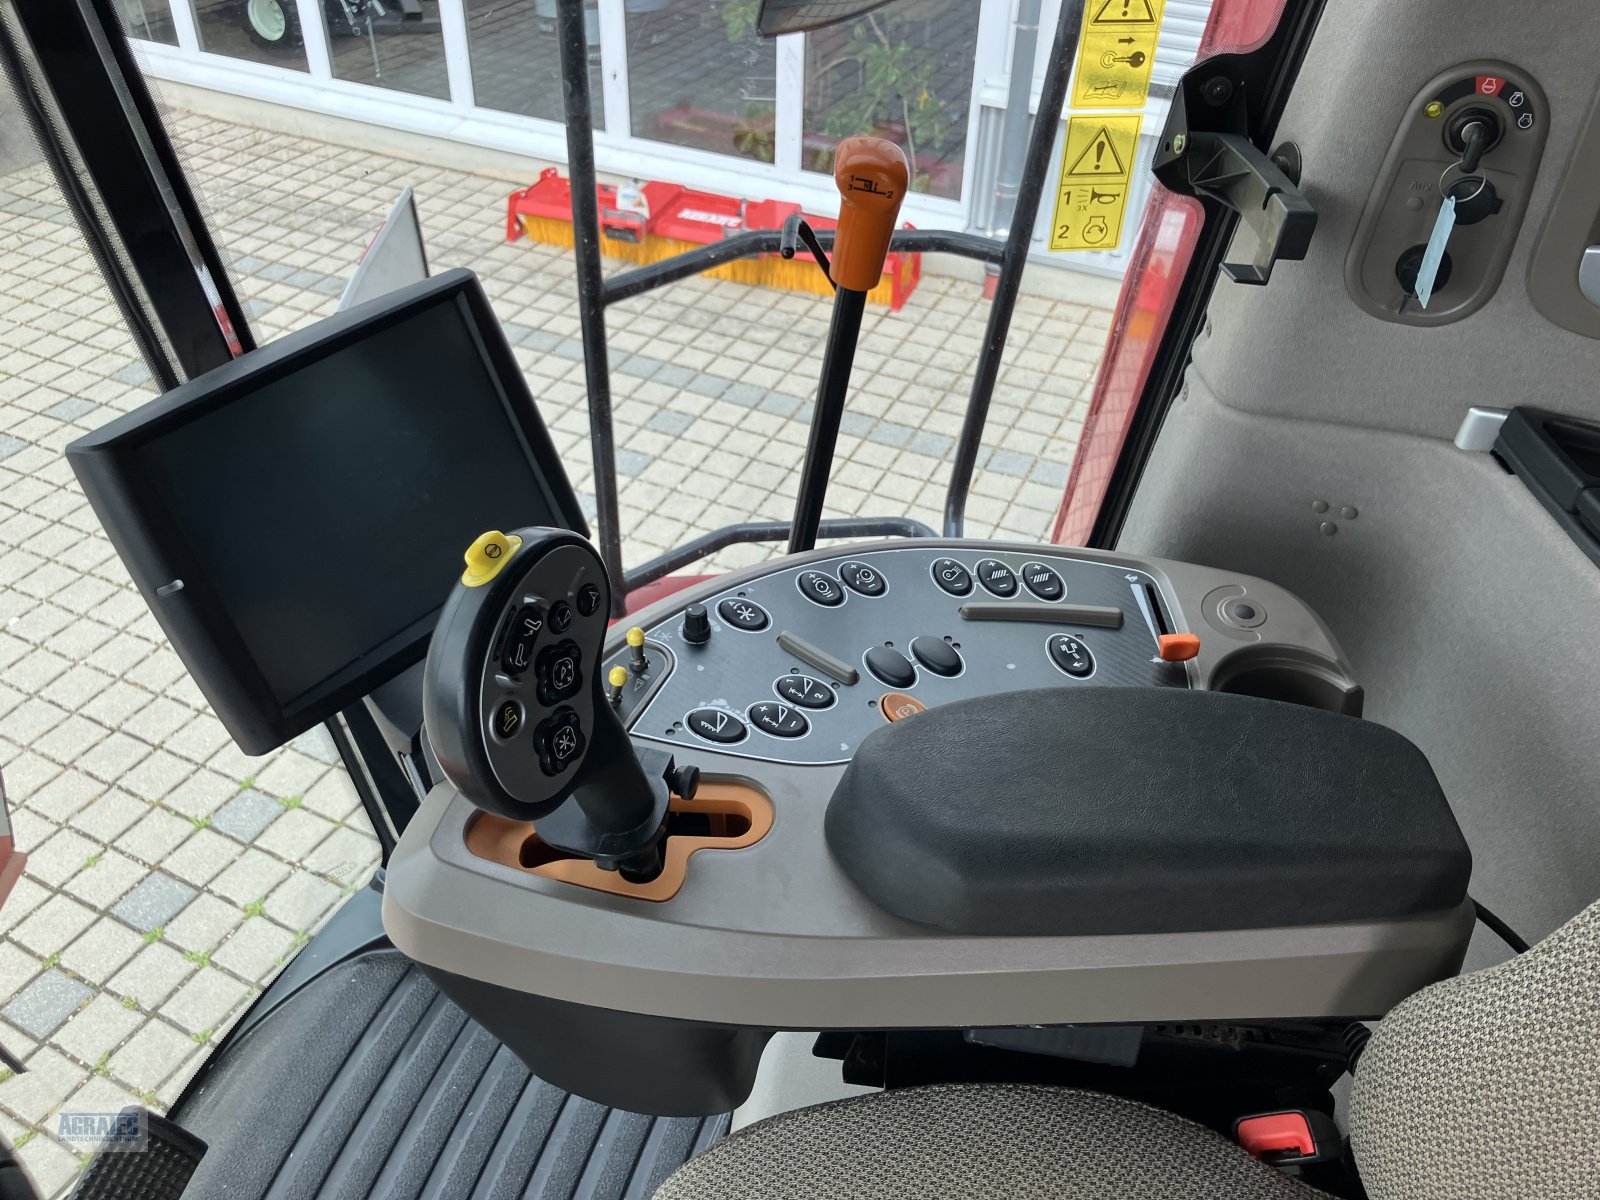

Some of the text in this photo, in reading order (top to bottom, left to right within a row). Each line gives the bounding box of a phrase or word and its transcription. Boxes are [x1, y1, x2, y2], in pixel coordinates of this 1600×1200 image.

[886, 191, 894, 199] 2
[1063, 190, 1072, 206] 1
[1057, 224, 1070, 239] 2
